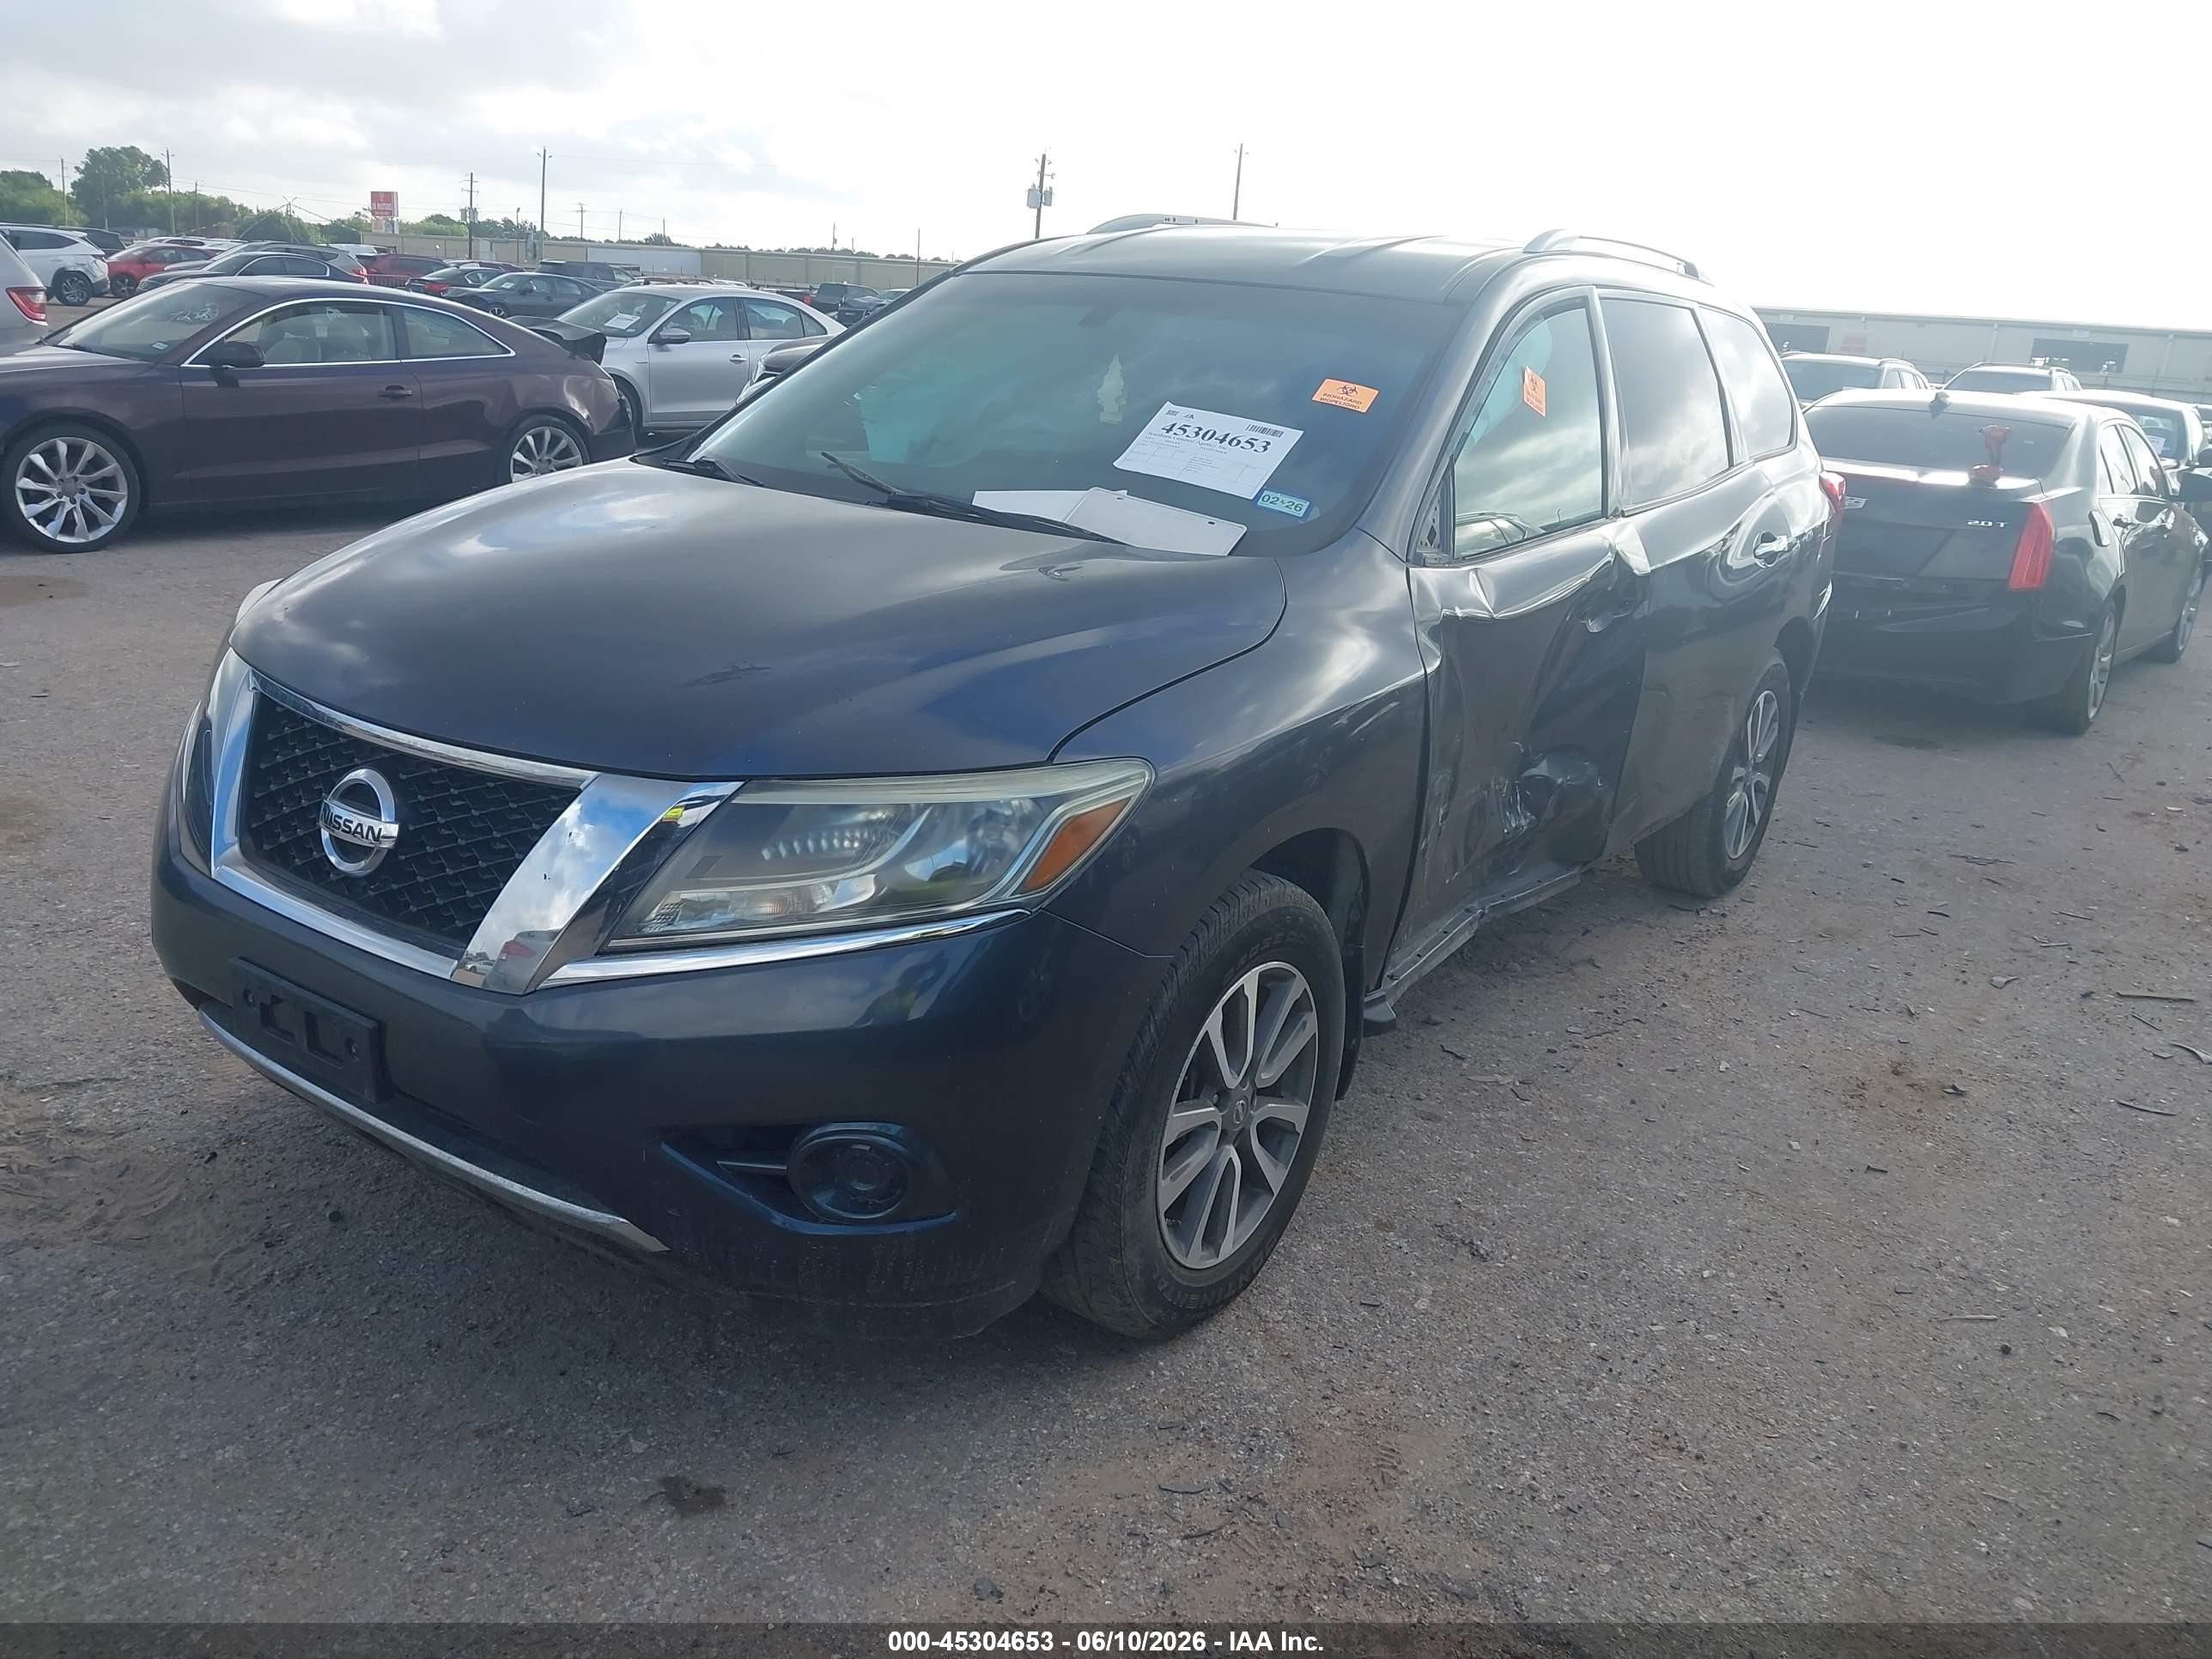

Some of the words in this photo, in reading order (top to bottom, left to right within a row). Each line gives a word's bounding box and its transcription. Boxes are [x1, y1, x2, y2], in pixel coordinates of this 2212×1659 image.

[1322, 392, 1362, 404] BIOHAZARD
[1160, 422, 1272, 453] 45304653
[321, 810, 382, 842] NISSAN
